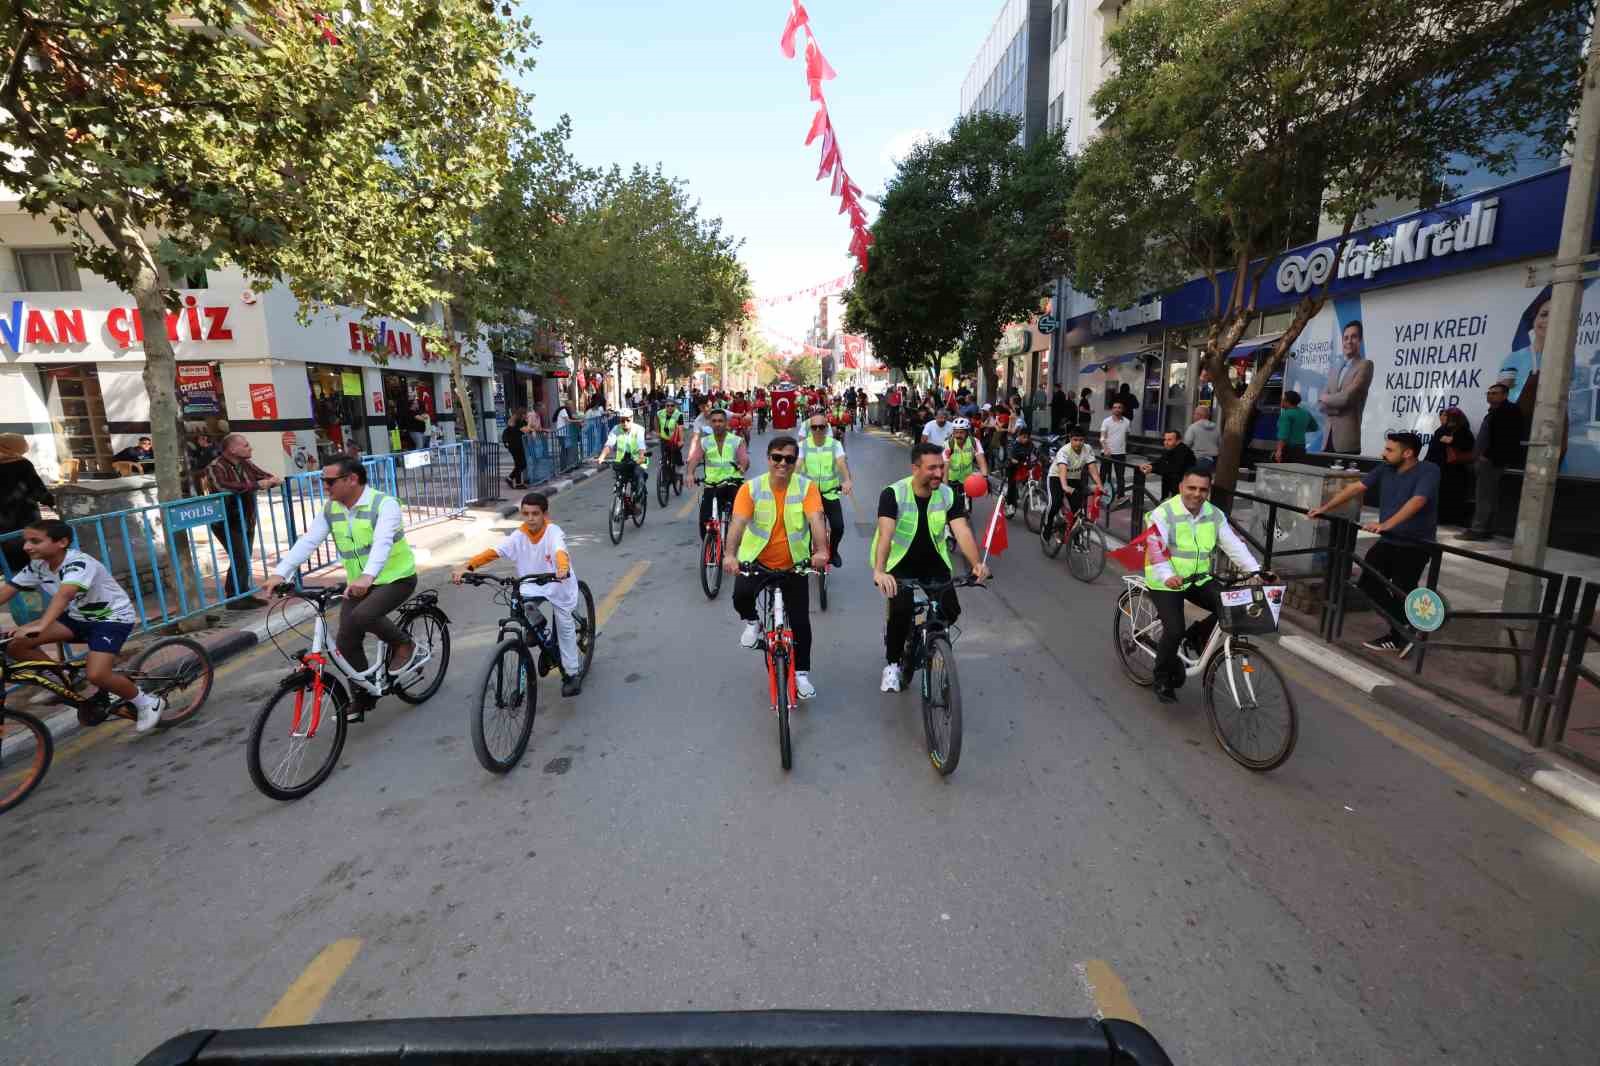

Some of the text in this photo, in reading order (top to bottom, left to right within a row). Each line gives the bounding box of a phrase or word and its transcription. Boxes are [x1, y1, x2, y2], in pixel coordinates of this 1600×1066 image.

[1394, 314, 1488, 343] YAPI KREDİ
[1394, 342, 1478, 366] SINIRLARI
[1385, 368, 1482, 390] KALDIRMAK
[1391, 395, 1421, 418] İÇİN
